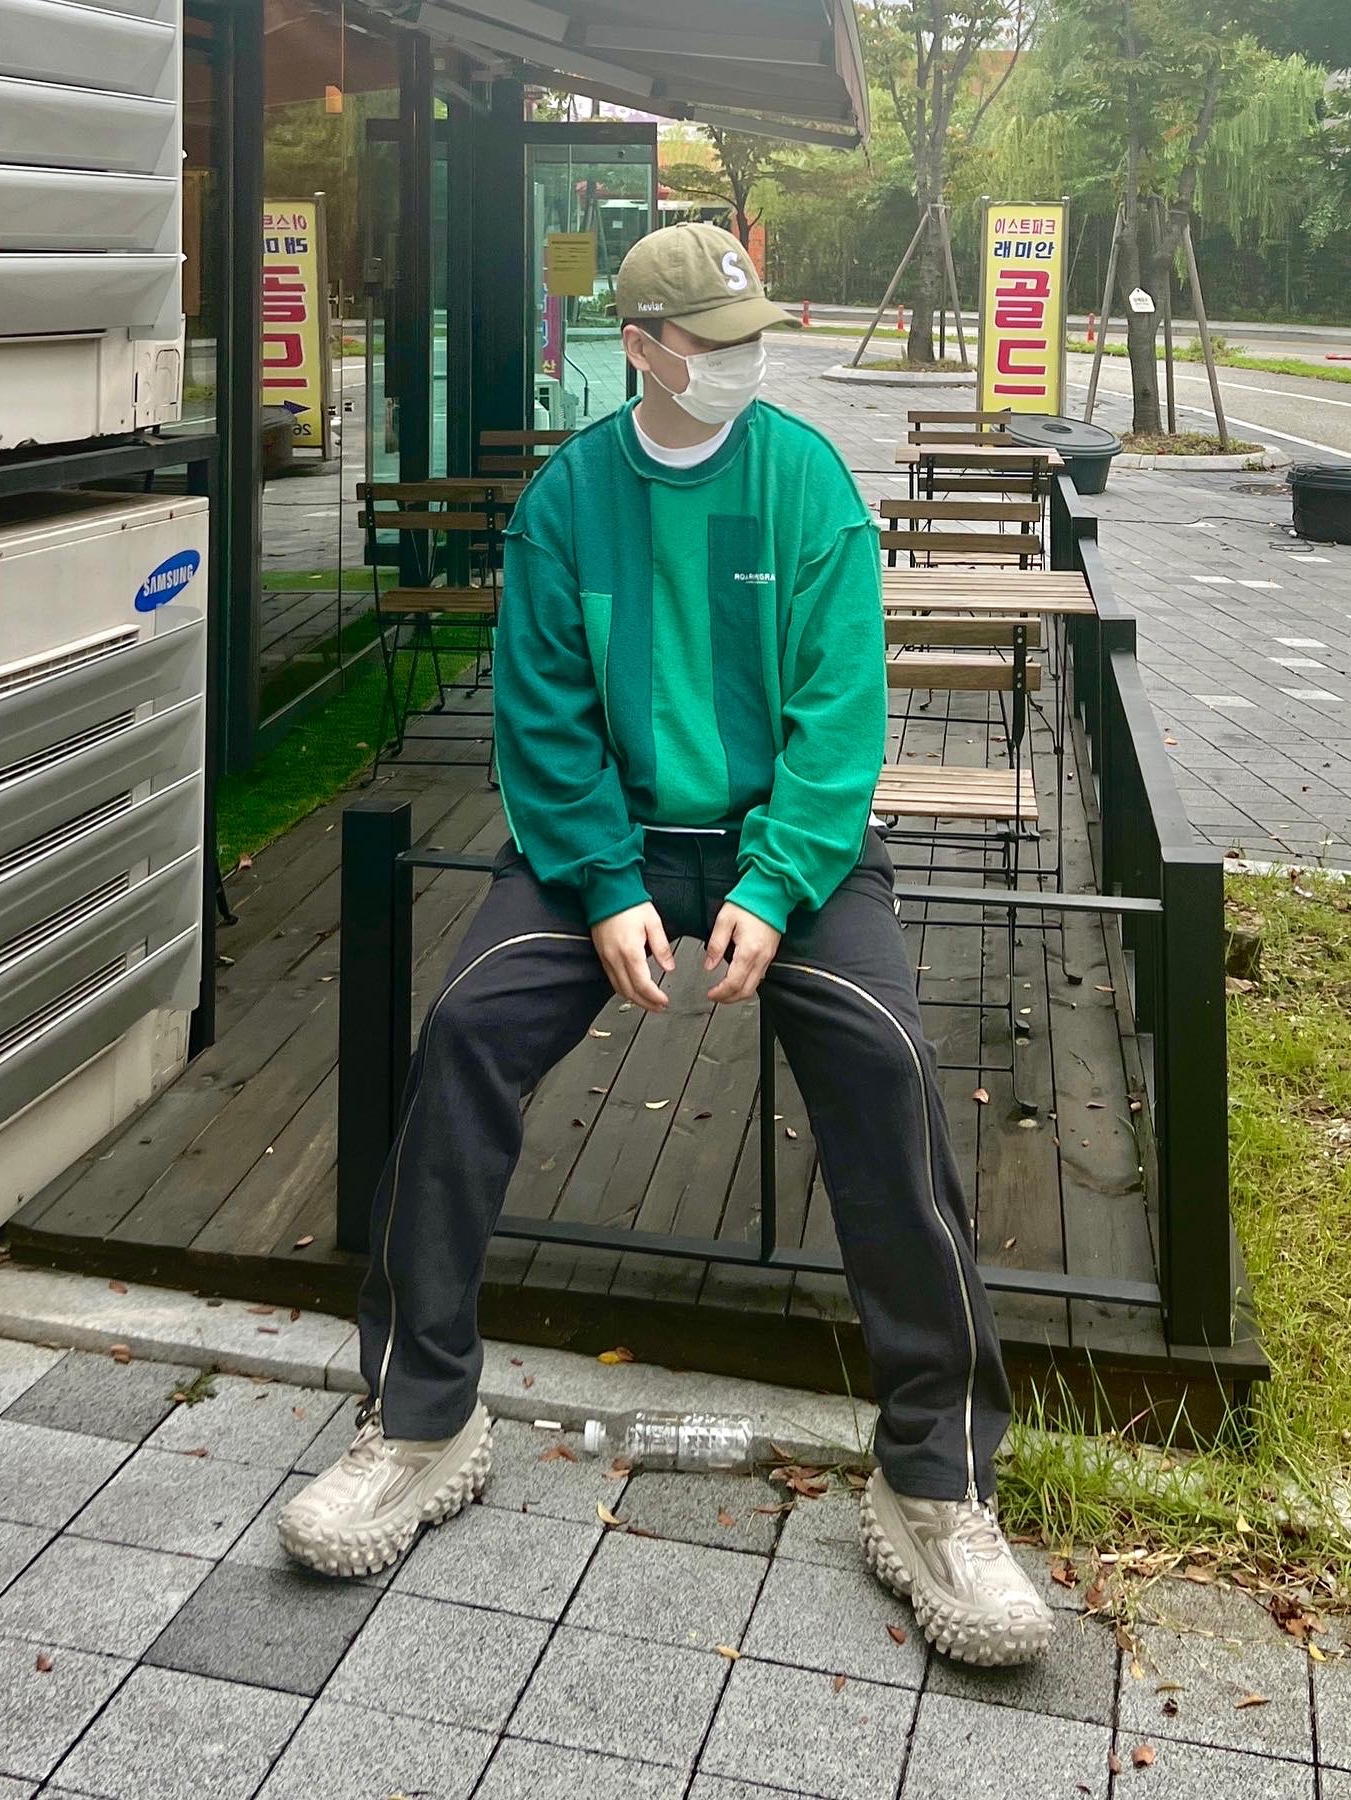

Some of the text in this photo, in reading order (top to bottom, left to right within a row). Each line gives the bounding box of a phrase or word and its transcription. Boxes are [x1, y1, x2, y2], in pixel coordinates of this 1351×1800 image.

[995, 218, 1056, 234] 이스트파크
[994, 241, 1055, 258] 래미안
[722, 251, 747, 291] S
[994, 270, 1050, 395] 골드
[143, 564, 194, 597] SAMSUNG
